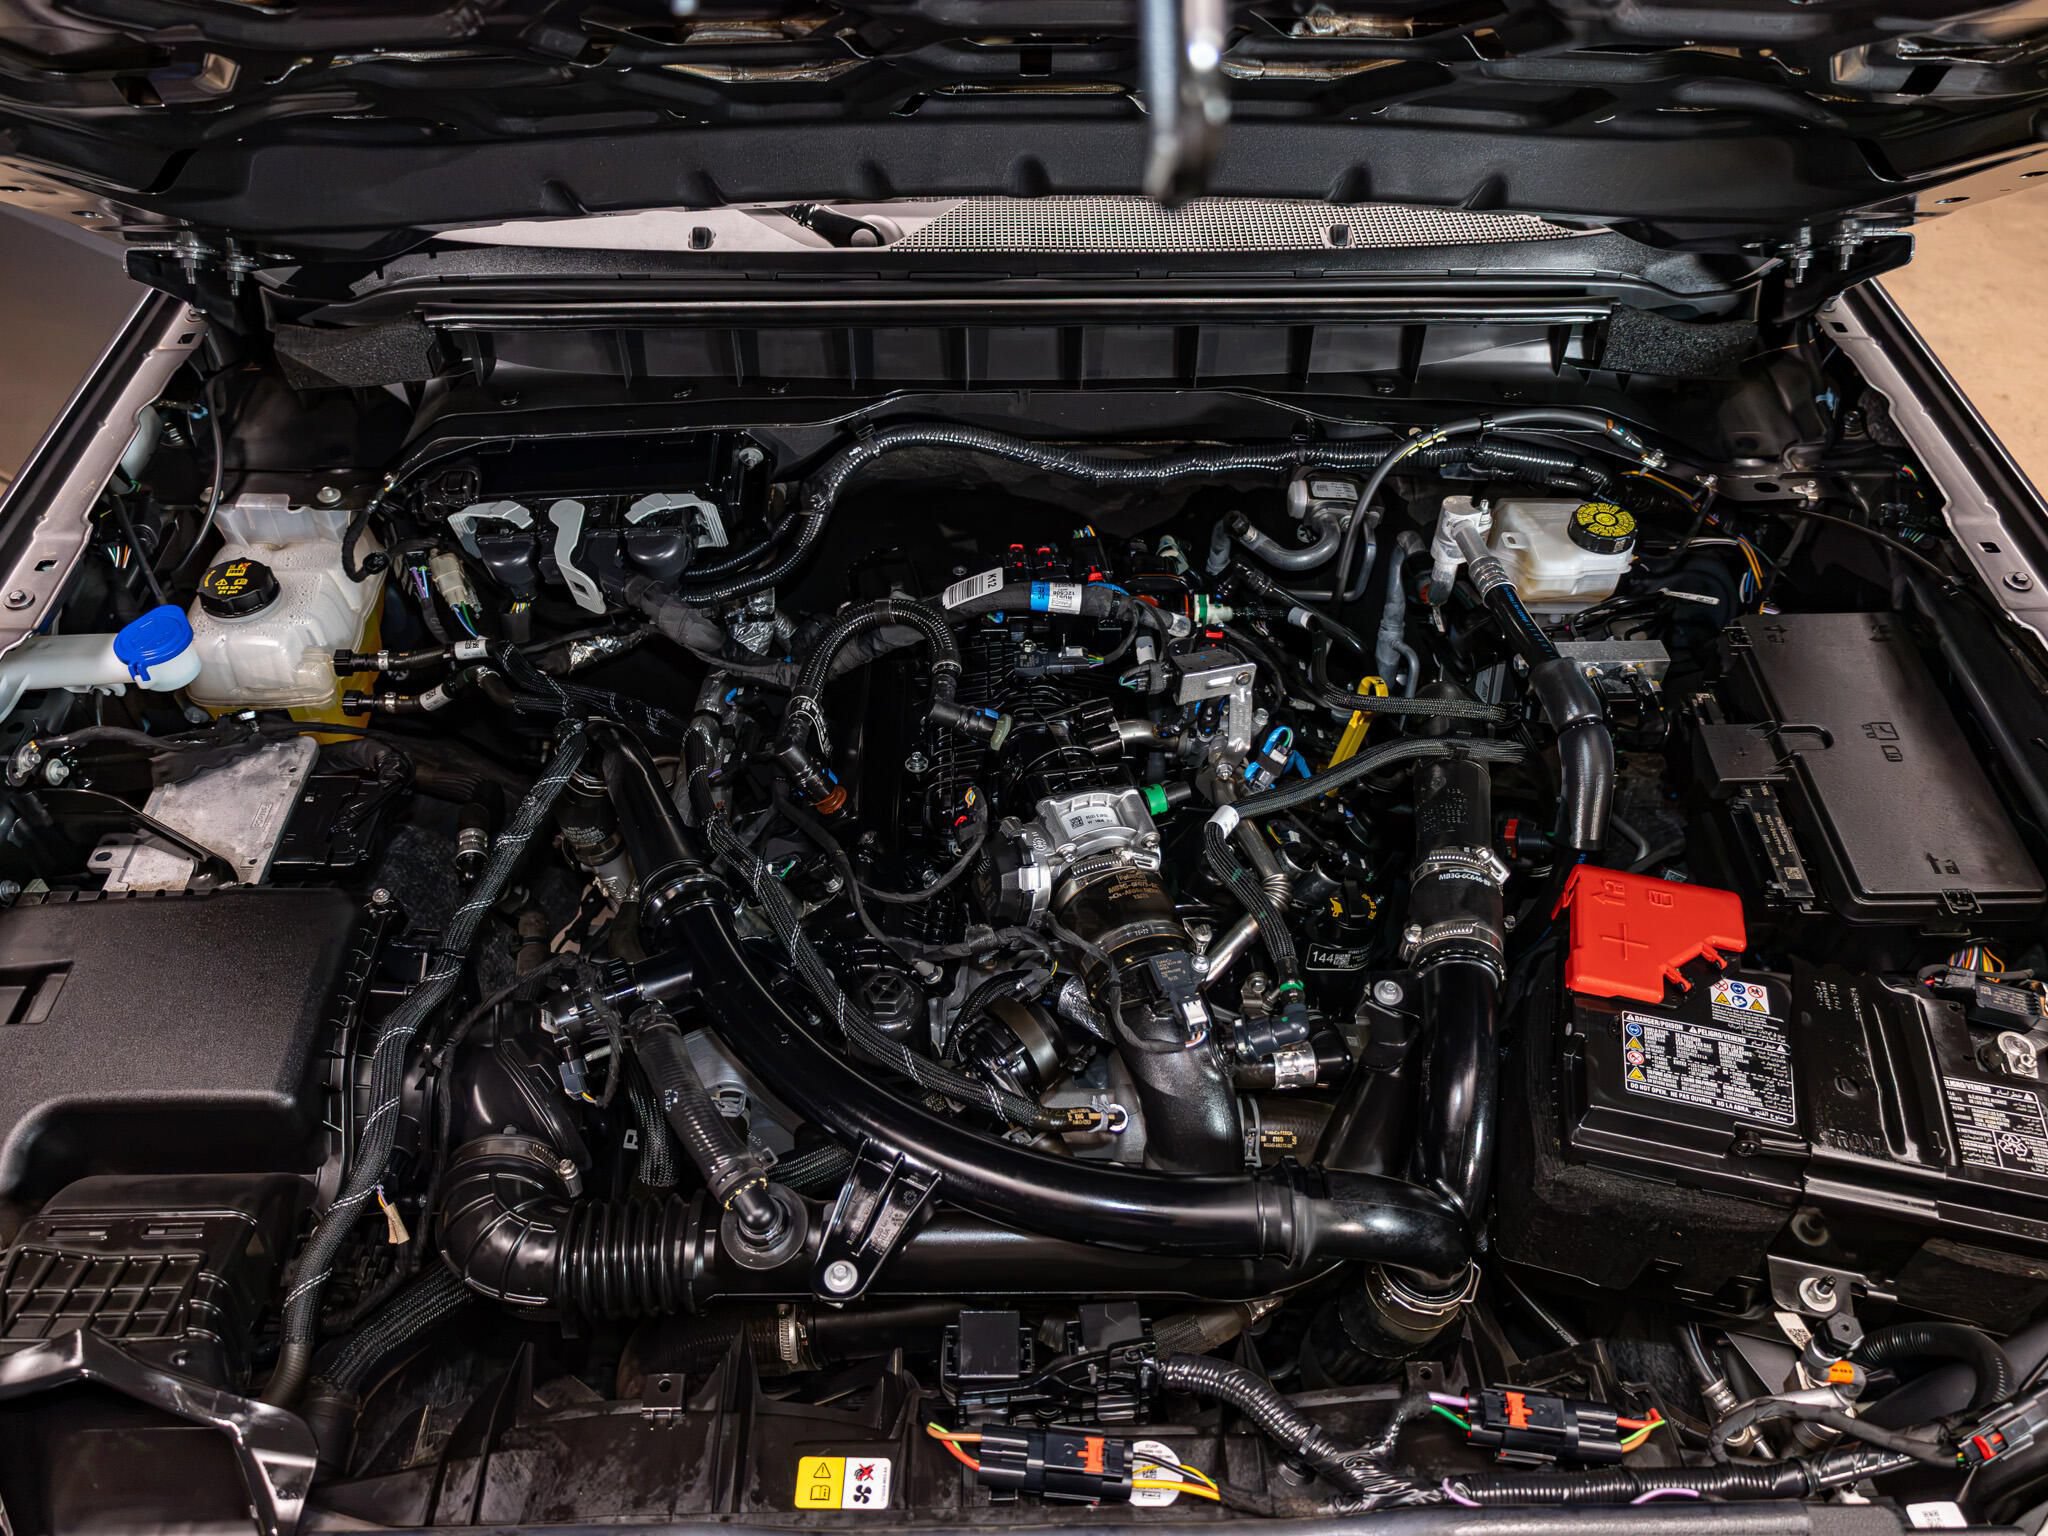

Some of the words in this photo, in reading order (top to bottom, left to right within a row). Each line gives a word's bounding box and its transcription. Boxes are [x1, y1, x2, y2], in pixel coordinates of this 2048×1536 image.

[987, 574, 997, 589] K12
[1312, 951, 1334, 963] 144
[1634, 1015, 1683, 1030] DANGER/POISON
[1697, 1028, 1746, 1044] PELIGRO/VENENO
[1651, 1086, 1668, 1095] OPEN.
[1679, 1092, 1690, 1100] PAS
[1691, 1095, 1714, 1105] OUVRIR.
[1828, 1128, 1881, 1150] FRONT
